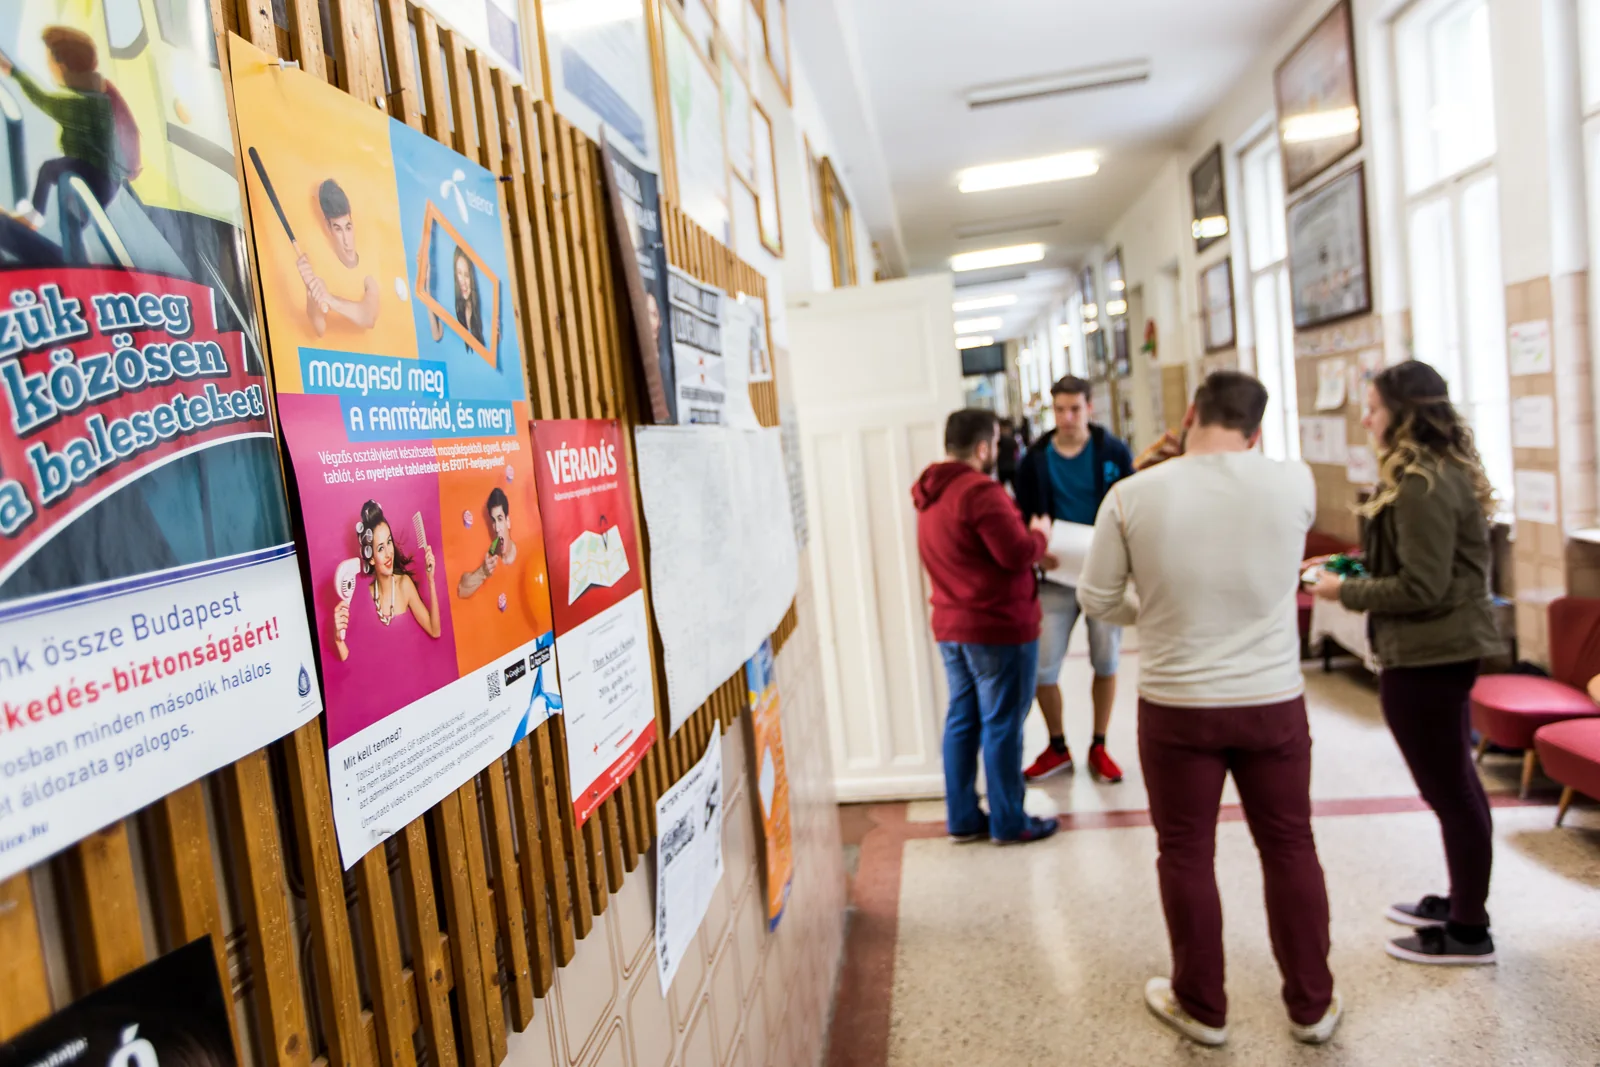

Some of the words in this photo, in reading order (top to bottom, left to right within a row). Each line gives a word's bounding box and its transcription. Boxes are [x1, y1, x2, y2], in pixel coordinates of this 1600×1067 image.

[465, 187, 494, 216] telenor
[91, 292, 192, 334] meg
[2, 333, 228, 434] közösen
[408, 366, 444, 399] meg
[349, 406, 364, 431] A
[457, 401, 474, 429] és
[0, 478, 34, 534] a
[26, 384, 266, 504] baleseteket!
[318, 449, 352, 467] Végzős
[353, 448, 399, 463] osztályként
[398, 445, 438, 460] készítsetek
[323, 468, 355, 484] tablót,
[355, 467, 365, 481] és
[366, 464, 404, 482] nyerjetek
[404, 461, 441, 476] tableteket
[545, 437, 618, 485] VÉRADÁS
[43, 627, 124, 667] össze
[131, 590, 242, 642] Budapest
[0, 616, 280, 736] kedés-biztonságáért!
[74, 709, 146, 750] minden
[150, 682, 218, 721] második
[221, 660, 272, 693] halálos
[22, 757, 109, 807] áldozata
[114, 723, 195, 771] gyalogos.
[343, 756, 356, 771] Mit
[357, 745, 372, 763] kell
[373, 727, 402, 753] tenned?
